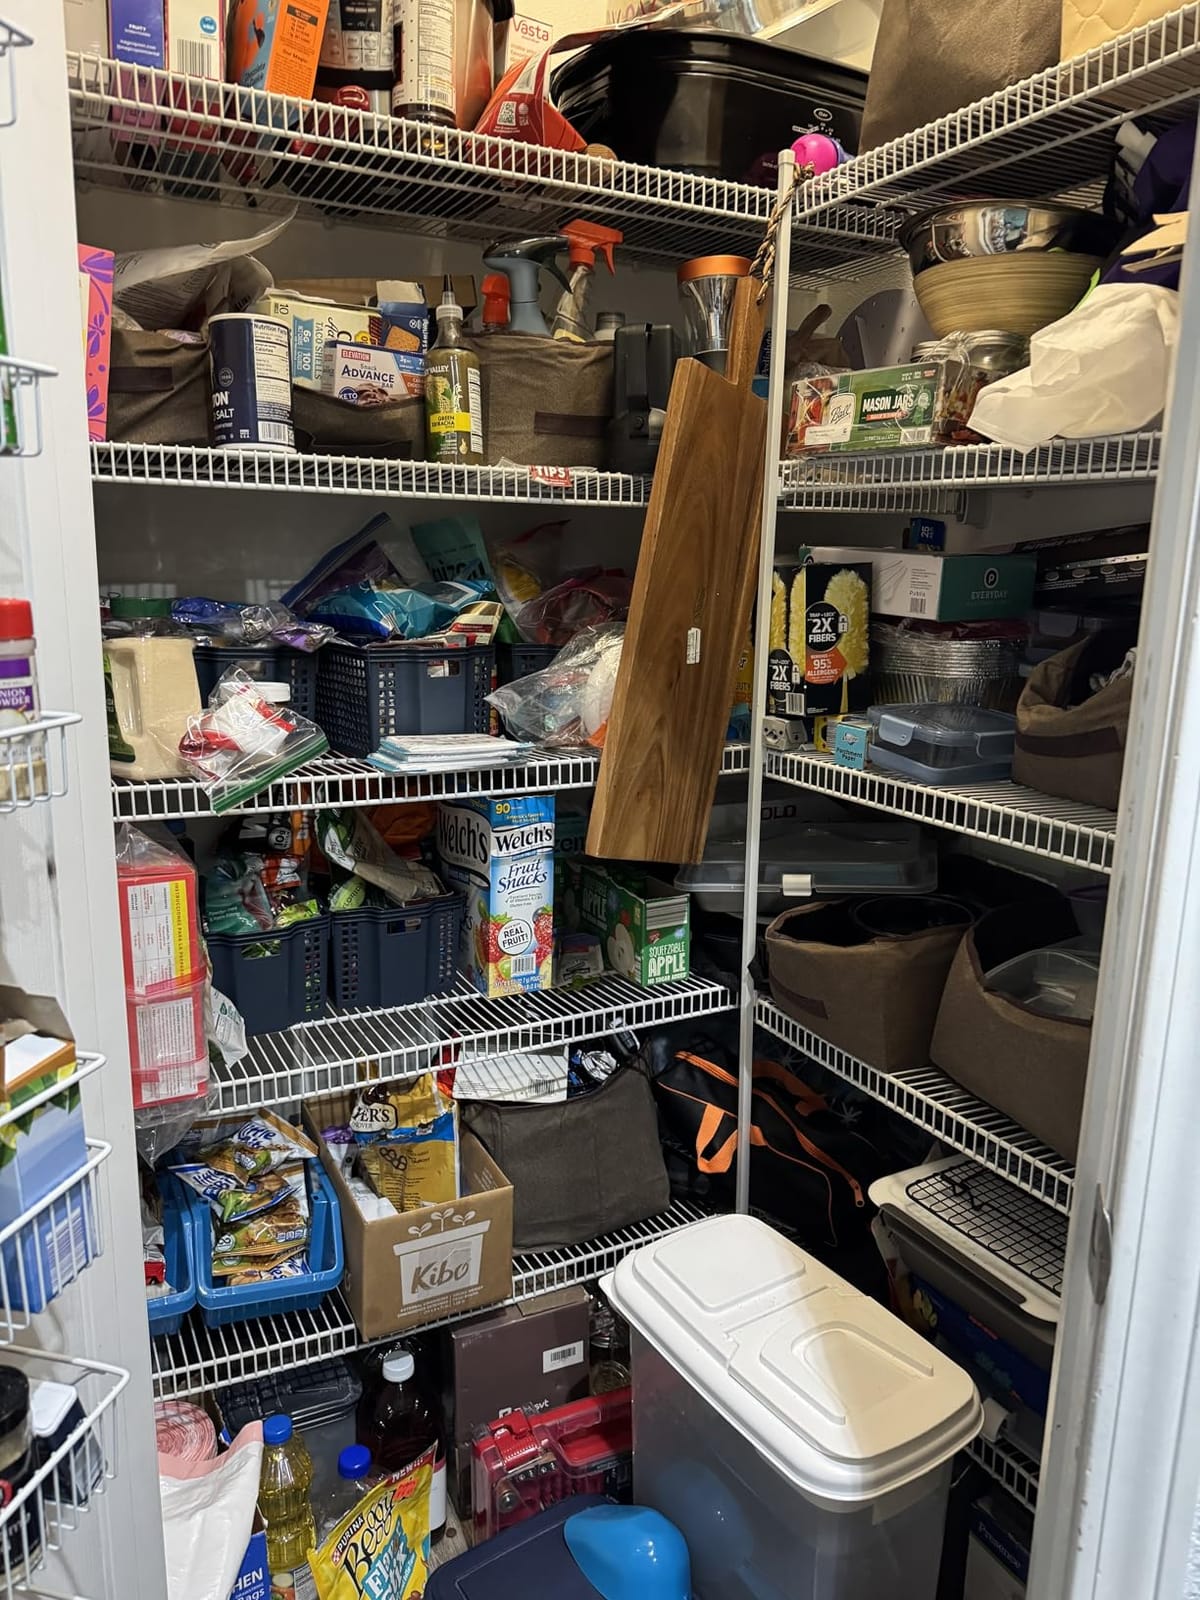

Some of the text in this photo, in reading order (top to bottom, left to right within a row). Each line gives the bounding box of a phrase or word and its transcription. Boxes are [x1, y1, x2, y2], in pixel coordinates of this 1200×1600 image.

[513, 16, 549, 41] Vasta
[280, 303, 289, 315] 10
[302, 352, 311, 371] 100
[431, 365, 449, 374] VALLEY
[342, 364, 395, 383] ADVANCE
[340, 392, 358, 400] KETO
[863, 394, 914, 412] MASON JARS
[216, 408, 235, 420] SALT
[830, 403, 852, 424] Ball
[535, 465, 566, 479] TIPS
[812, 618, 832, 634] 2X
[809, 633, 837, 644] FIBERS
[772, 666, 788, 681] 2X
[807, 669, 838, 677] ALLERGENS
[0, 687, 26, 699] NION
[770, 681, 791, 691] FIBERS
[496, 803, 511, 815] 90
[438, 806, 488, 865] Welch's
[495, 826, 553, 852] Welch's
[509, 858, 543, 879] Fruit
[497, 871, 548, 893] Snacks
[503, 926, 524, 939] REAL
[502, 935, 529, 948] FRUIT!
[649, 941, 686, 958] SQUEEZABLE
[648, 952, 686, 978] APPLE
[411, 1260, 470, 1295] Kibo
[337, 1516, 364, 1554] PURINA
